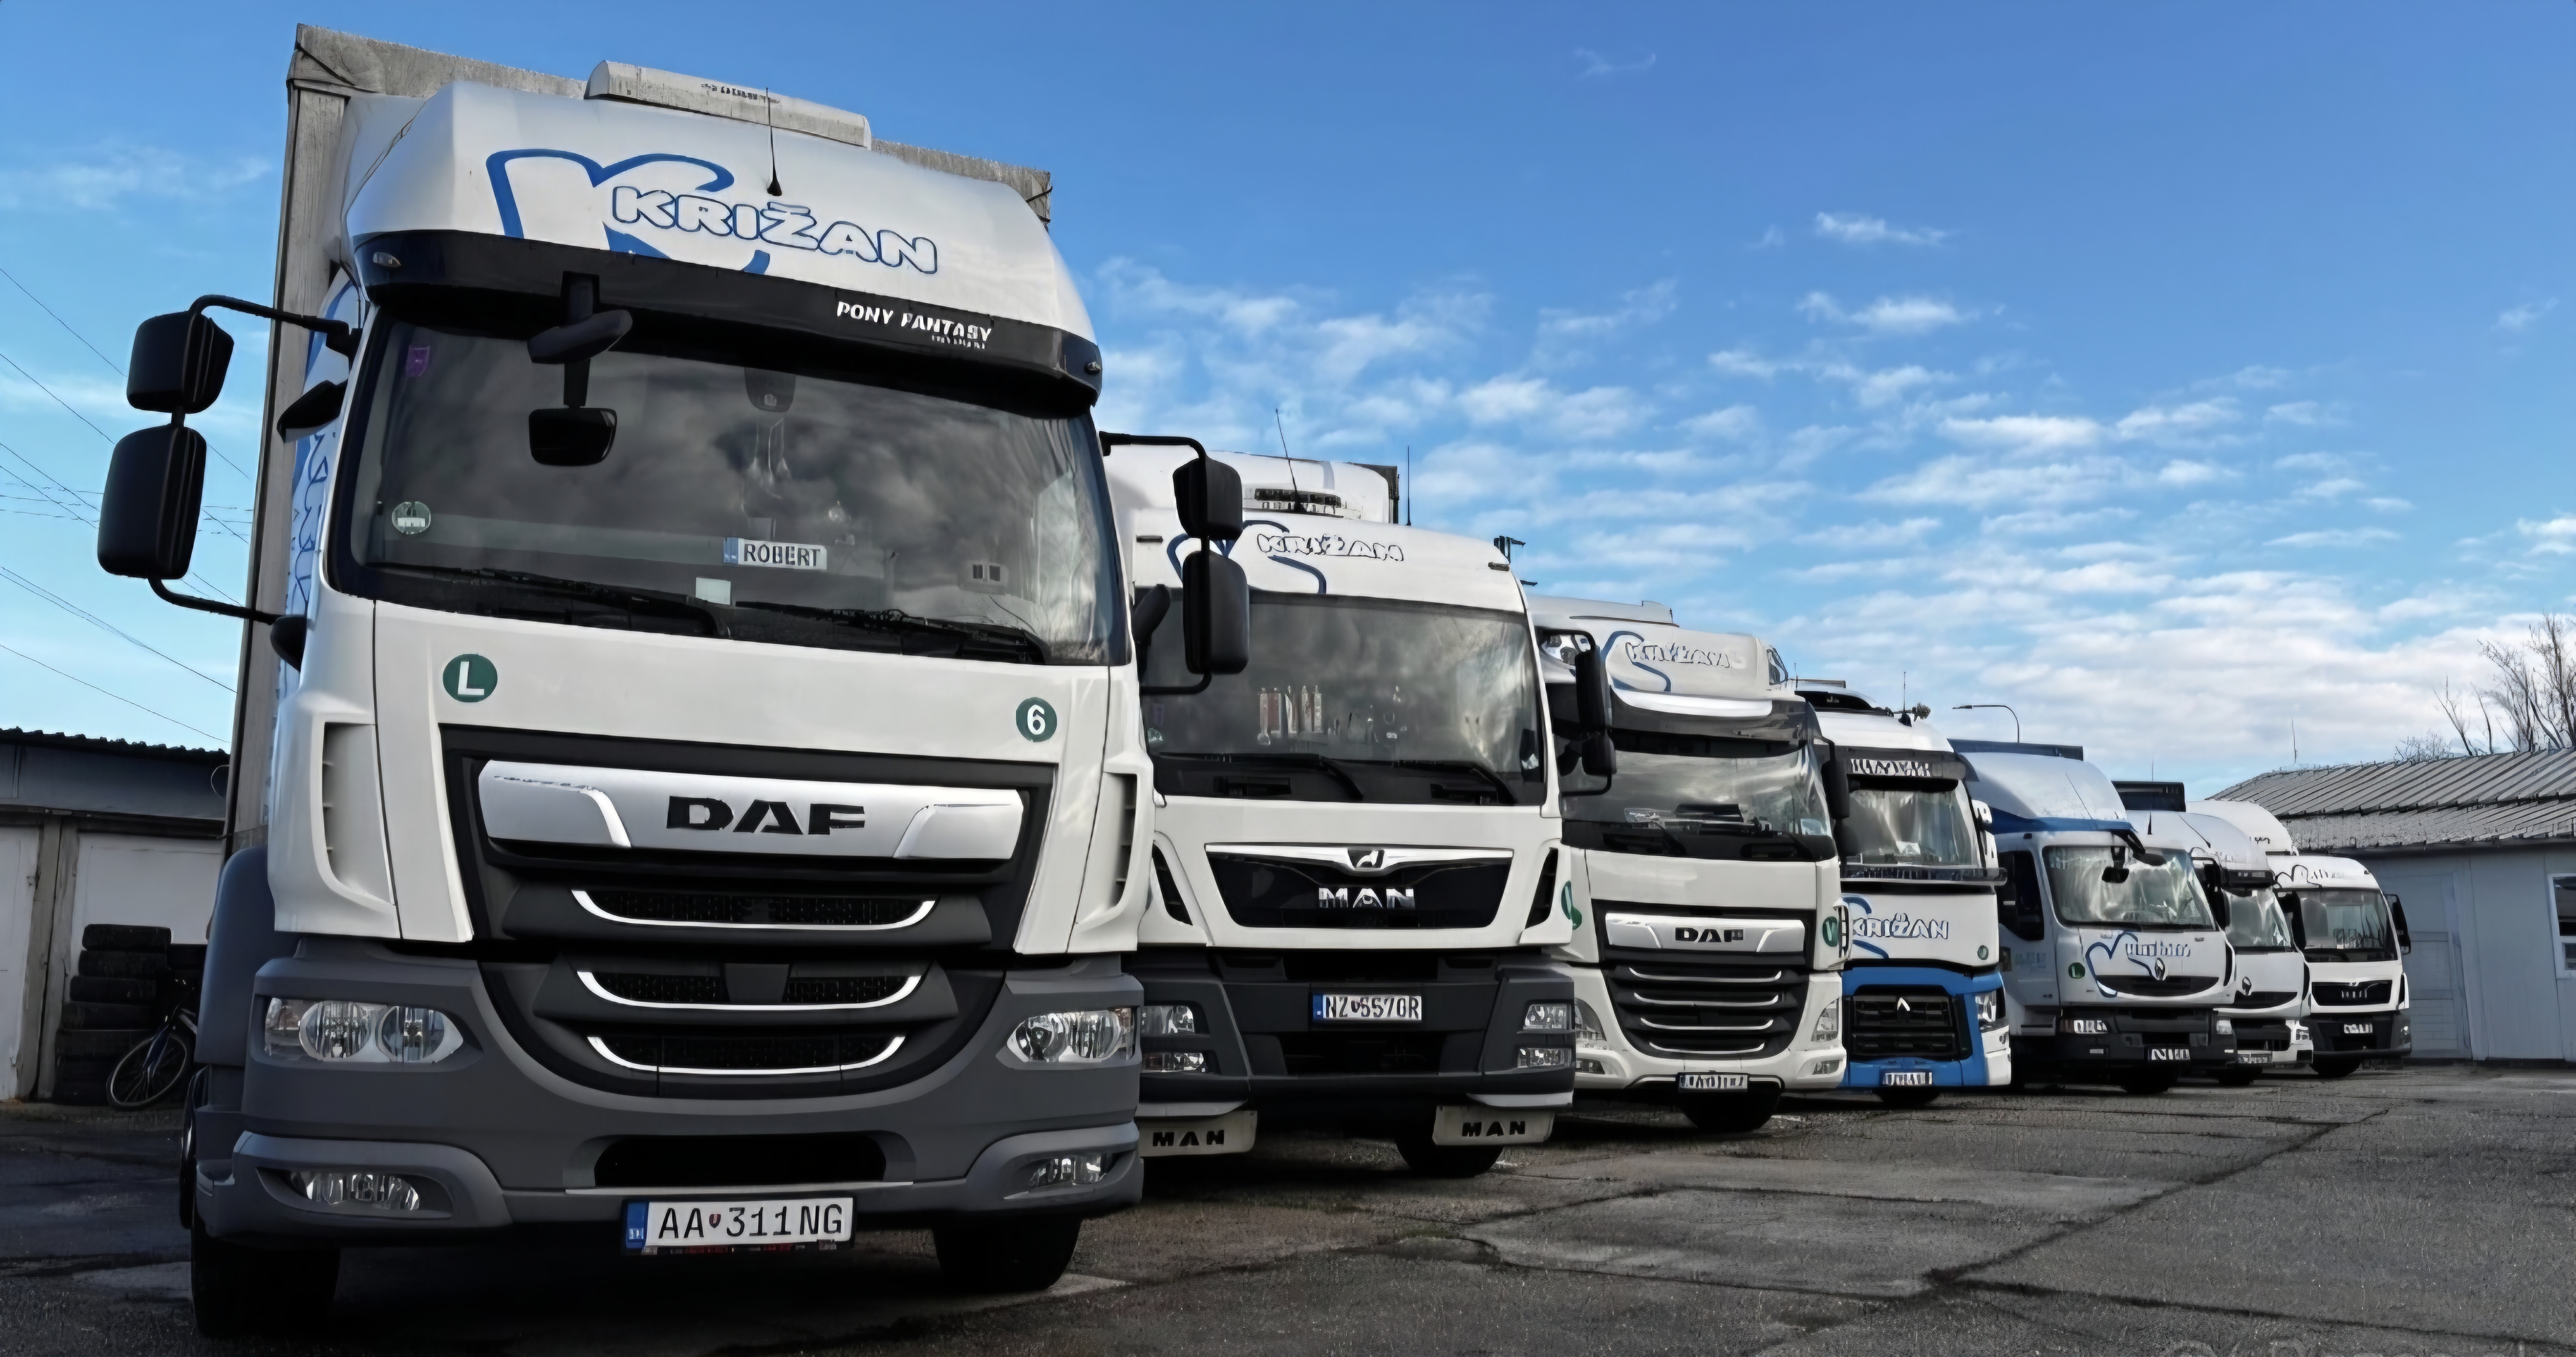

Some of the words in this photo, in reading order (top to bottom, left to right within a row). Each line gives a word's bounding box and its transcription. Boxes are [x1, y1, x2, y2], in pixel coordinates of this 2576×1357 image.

[612, 185, 938, 274] KRIŽAN
[837, 301, 894, 324] PONY
[457, 661, 485, 695] L
[1027, 704, 1046, 735] 6
[666, 796, 865, 835] DAF
[1318, 887, 1416, 908] MAN
[1153, 1129, 1224, 1147] MAN
[1462, 1121, 1525, 1137] MAN
